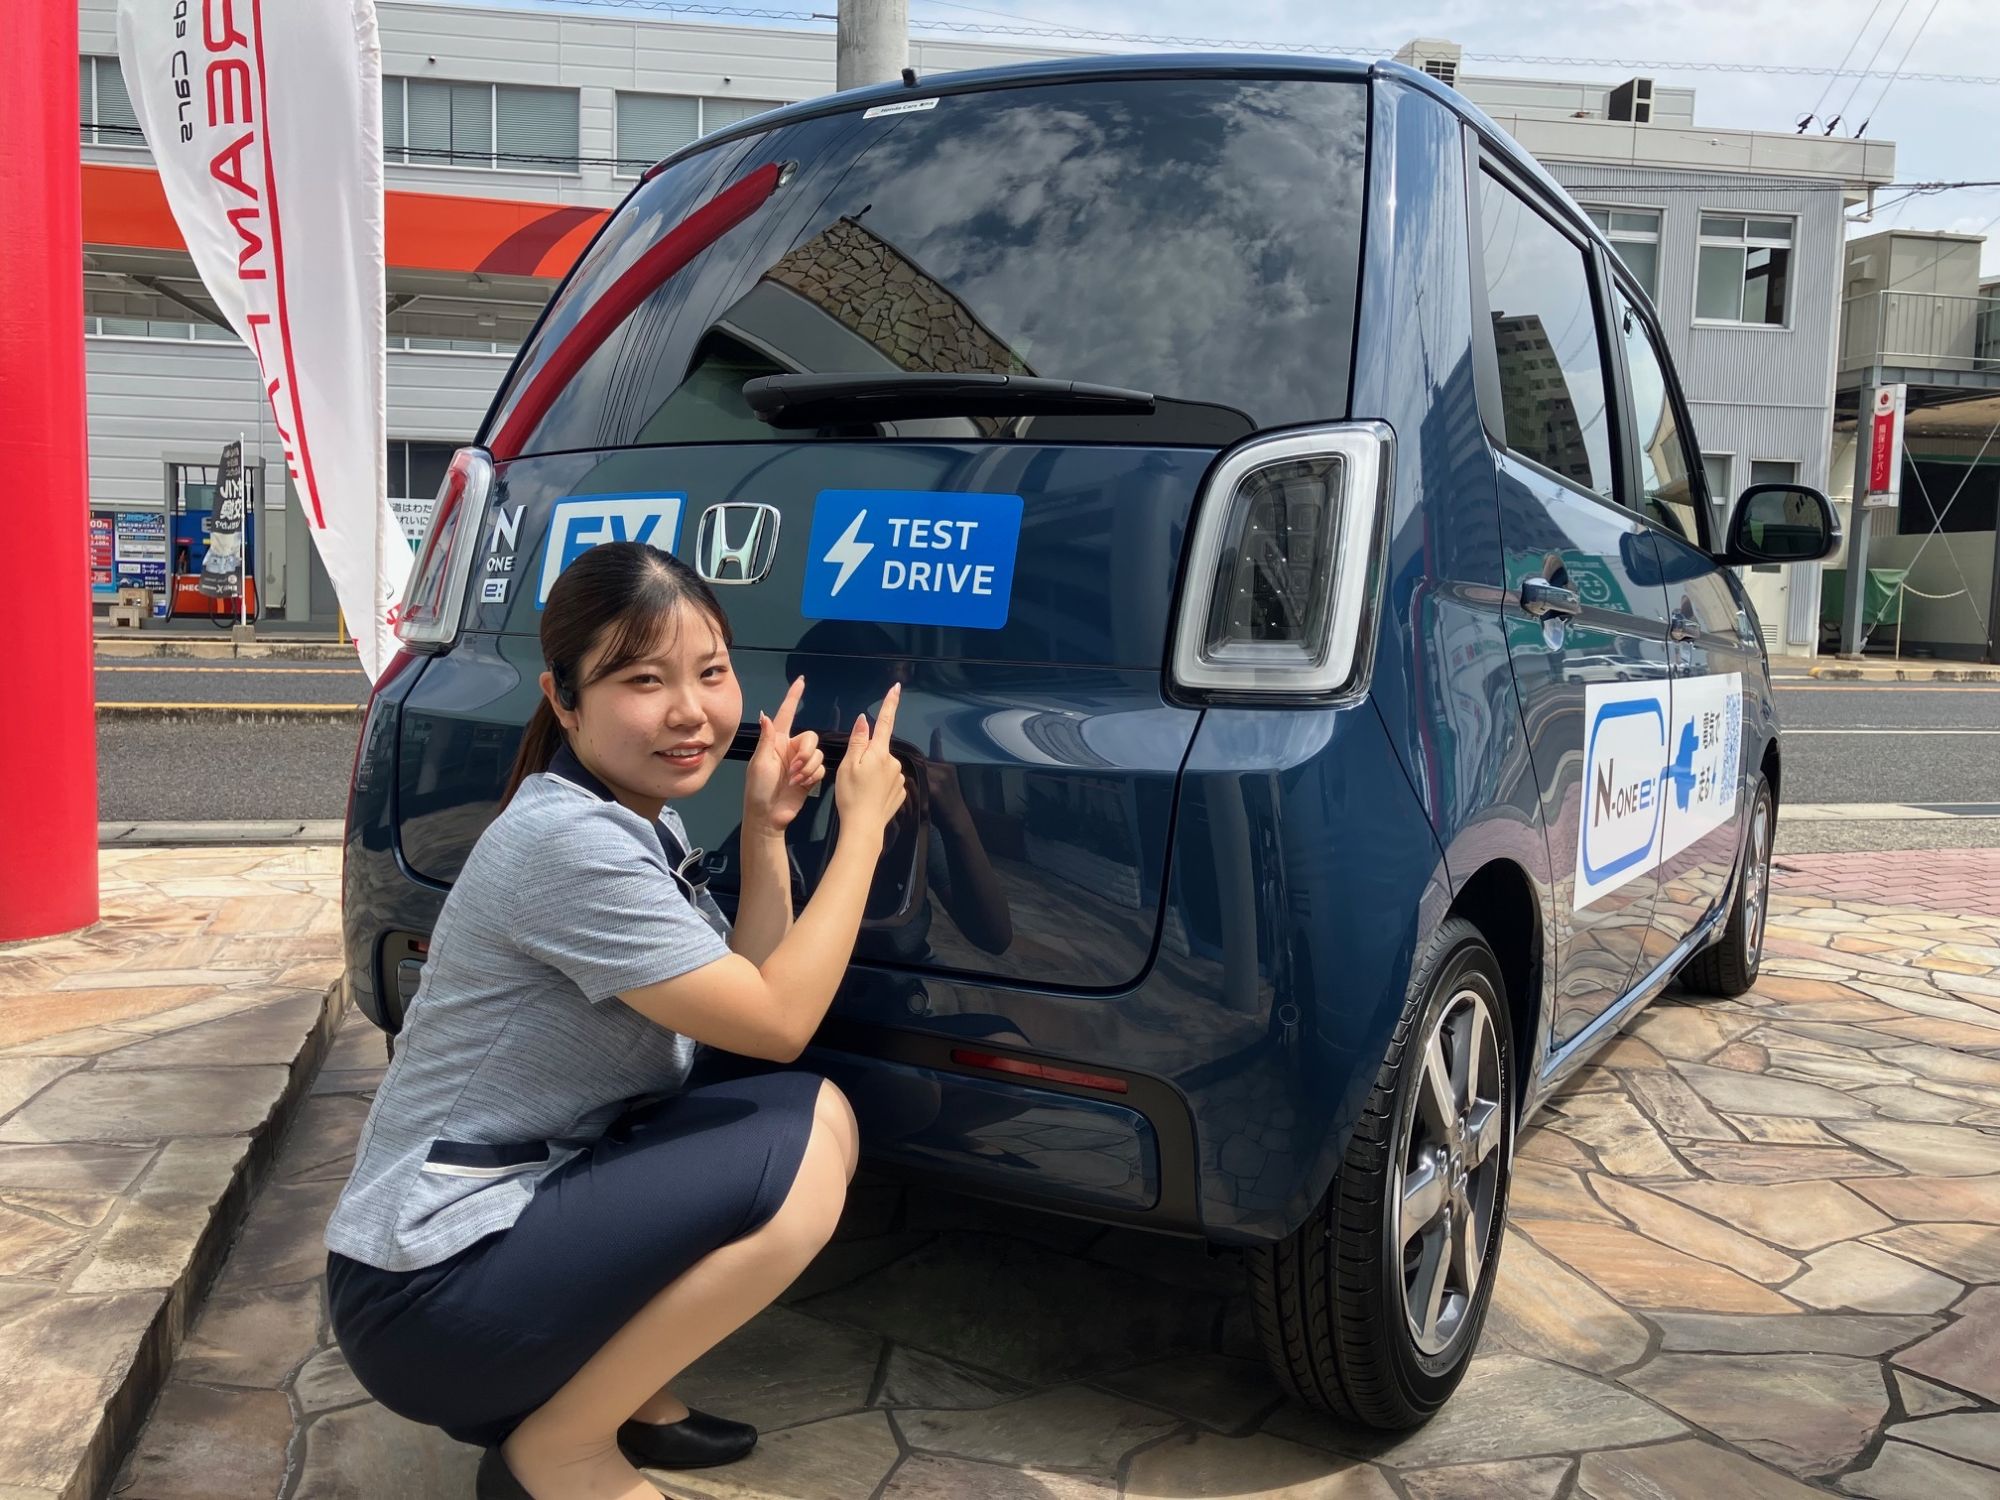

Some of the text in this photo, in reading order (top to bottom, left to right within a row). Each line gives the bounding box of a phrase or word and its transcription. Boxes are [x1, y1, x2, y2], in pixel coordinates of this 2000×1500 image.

[396, 515, 430, 527] れいに
[490, 504, 527, 553] N
[888, 518, 979, 551] TEST
[486, 556, 514, 573] ONE
[881, 560, 995, 595] DRIVE
